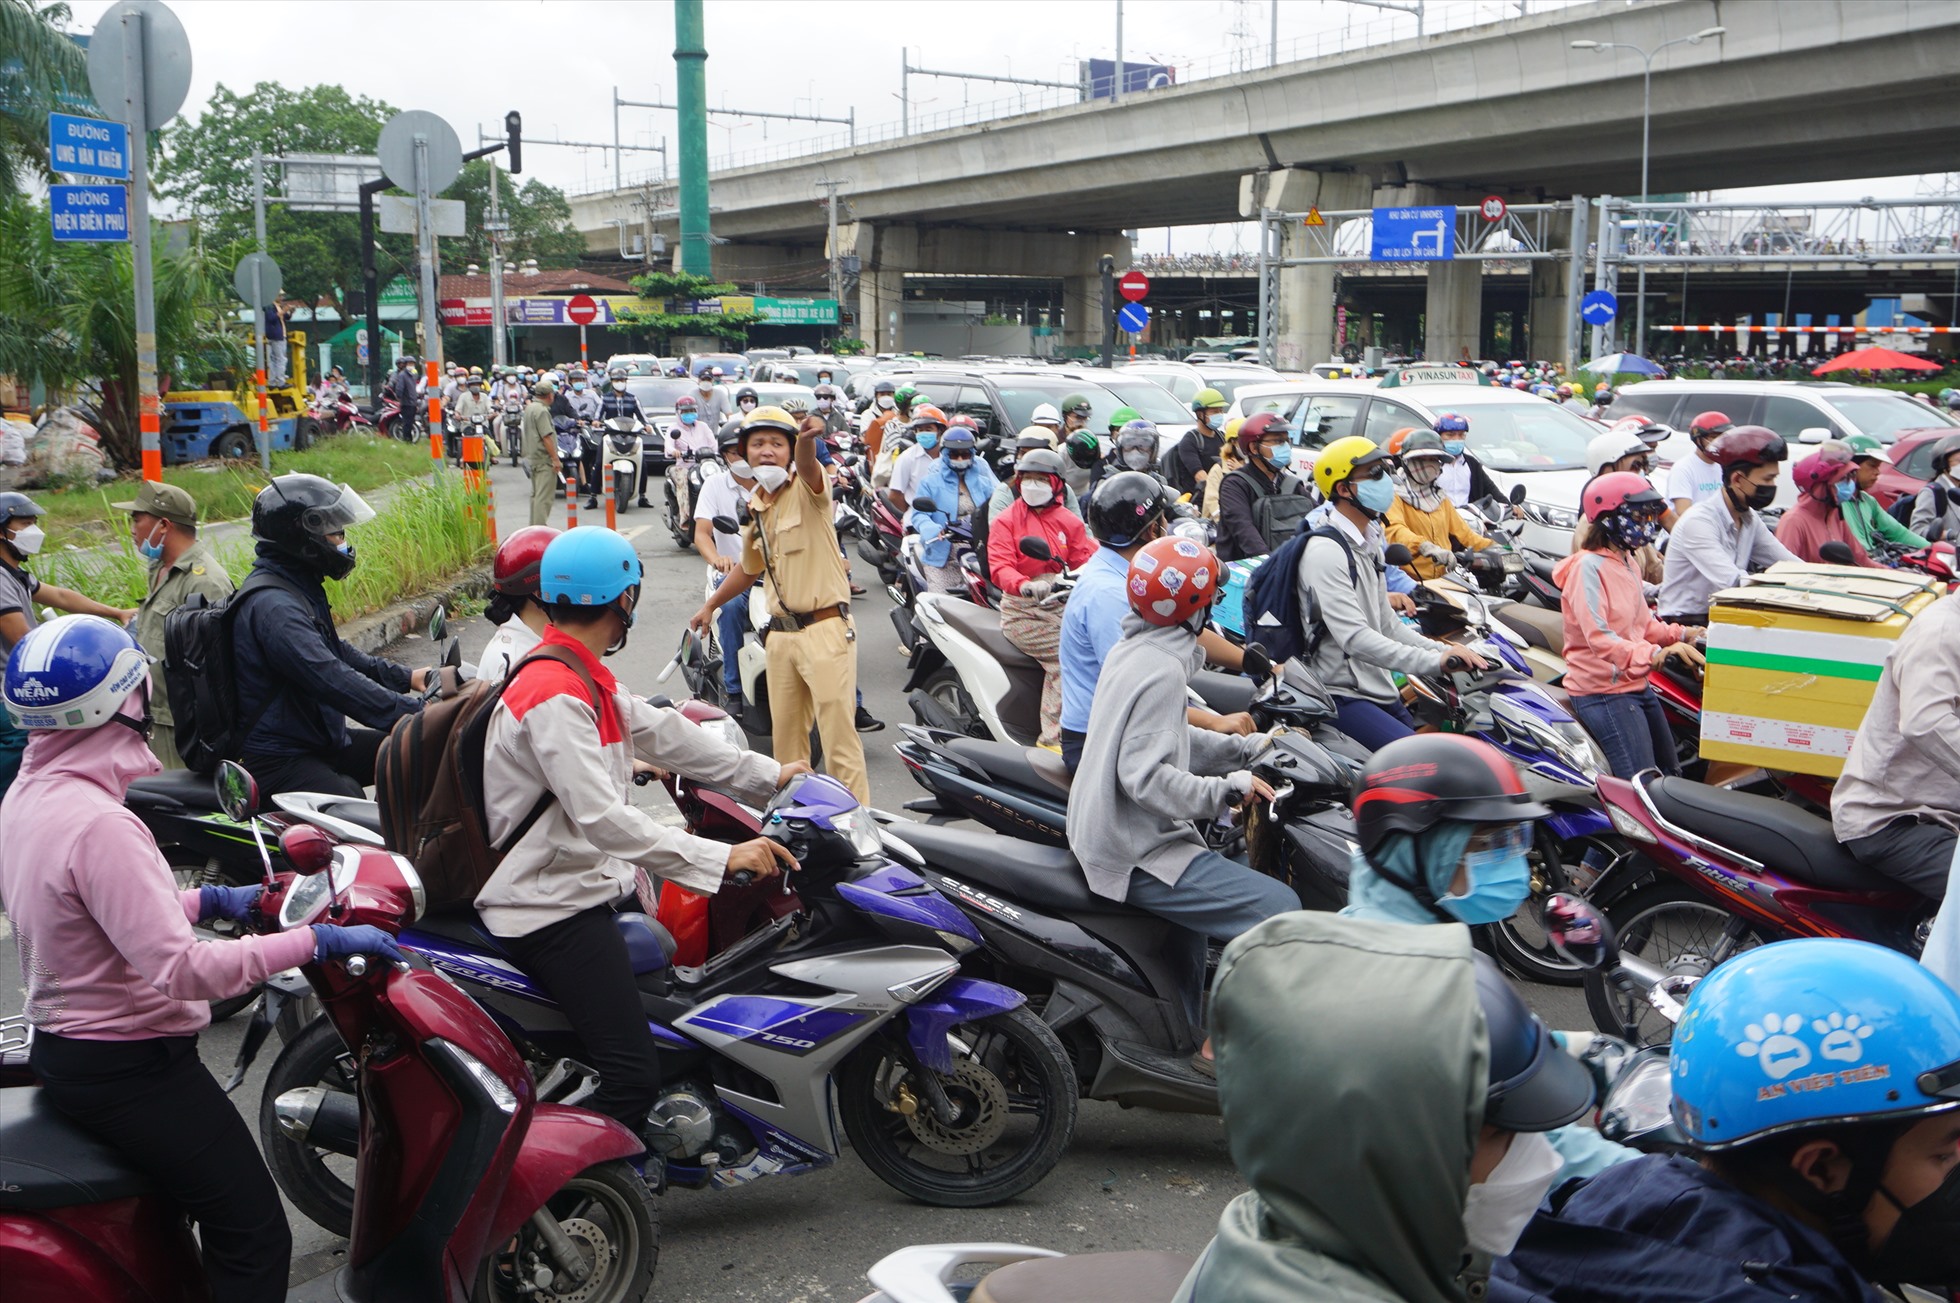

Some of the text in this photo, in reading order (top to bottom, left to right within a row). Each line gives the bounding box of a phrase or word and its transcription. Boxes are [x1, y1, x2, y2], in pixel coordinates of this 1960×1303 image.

[67, 122, 110, 142] ĐƯỜNG
[67, 189, 110, 206] ĐƯỜNG
[54, 206, 125, 234] ĐIỆN BIÊN PHỦ
[1142, 498, 1153, 510] LG
[13, 686, 59, 698] WEAN
[941, 876, 1022, 920] CLICK
[761, 1032, 816, 1049] 150
[1757, 1083, 1787, 1102] AN
[1788, 1072, 1837, 1095] VIỆT
